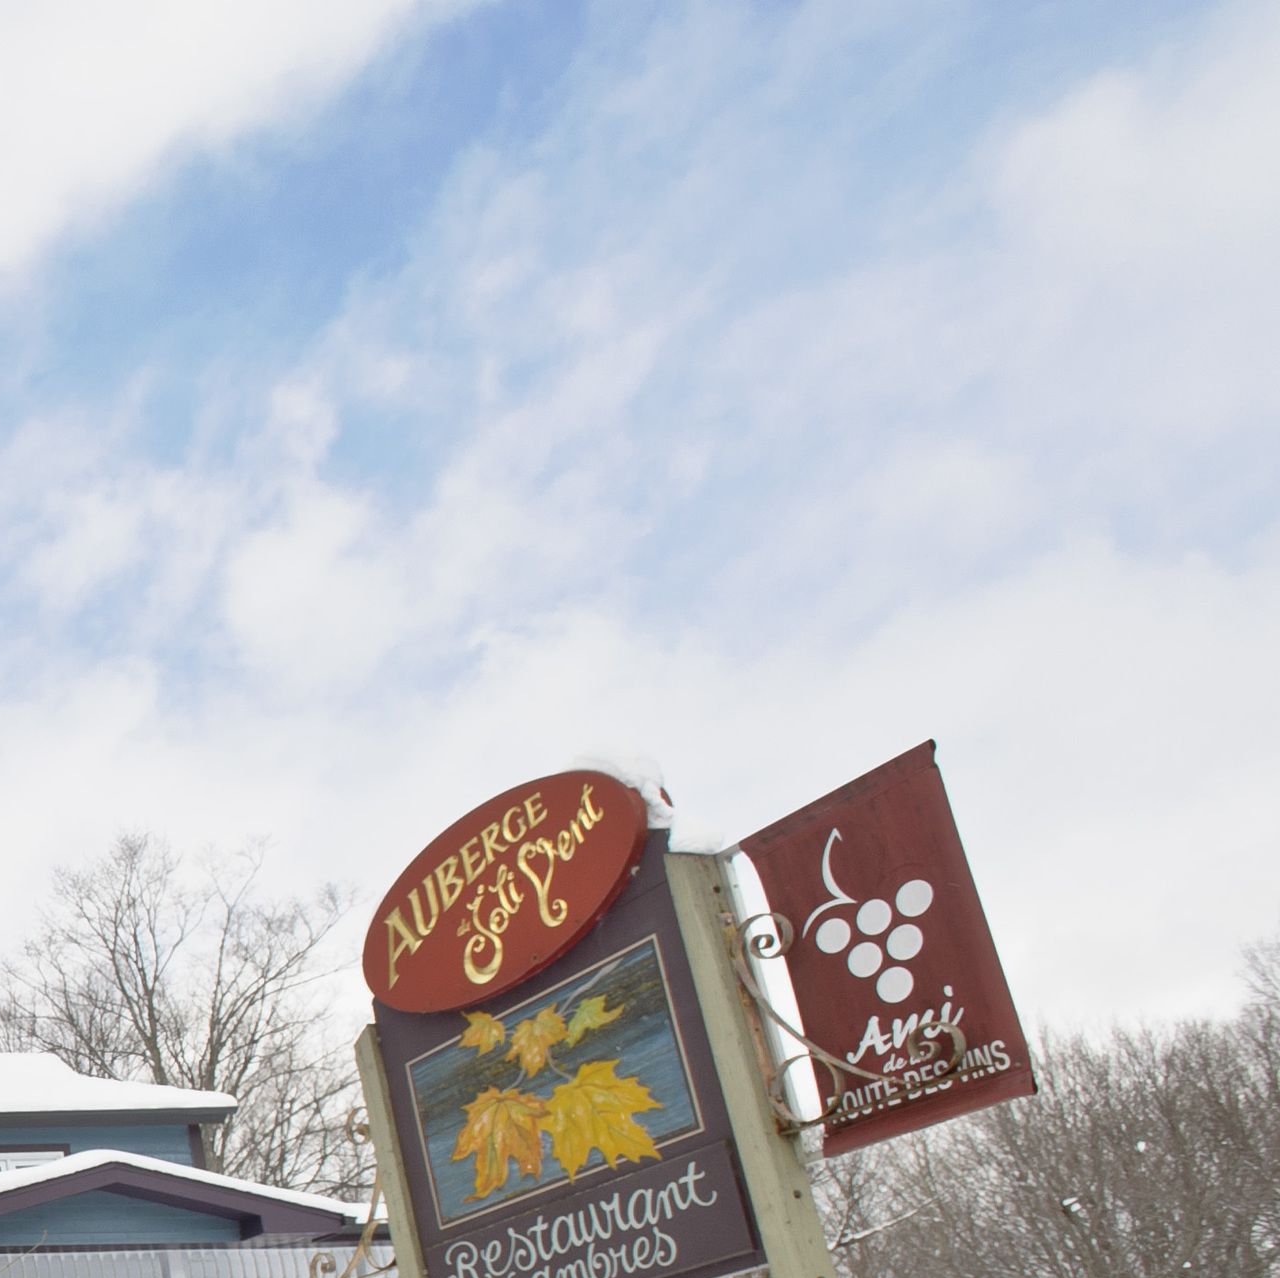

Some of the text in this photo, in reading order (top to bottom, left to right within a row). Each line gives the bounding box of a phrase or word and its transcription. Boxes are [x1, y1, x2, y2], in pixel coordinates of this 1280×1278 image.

[384, 792, 548, 990] AUBERGE
[846, 985, 964, 1064] Ami
[883, 1053, 908, 1074] de
